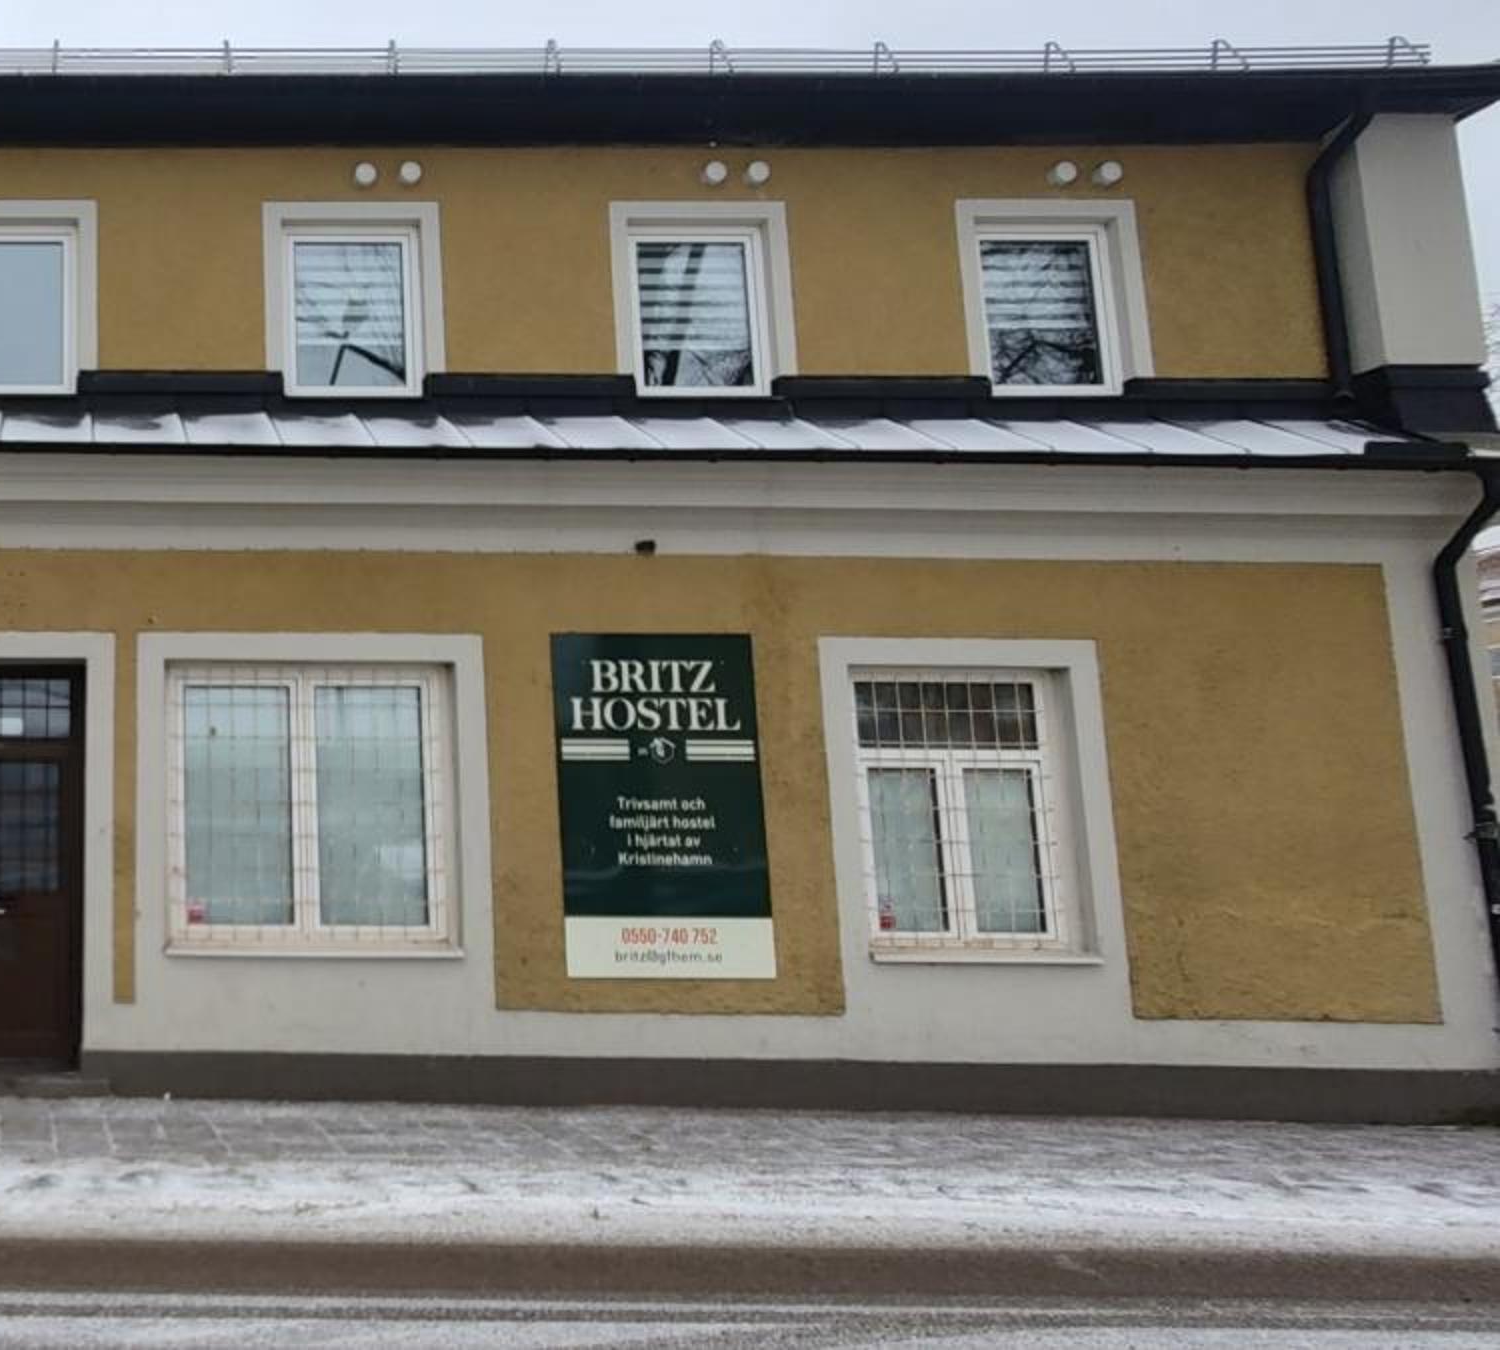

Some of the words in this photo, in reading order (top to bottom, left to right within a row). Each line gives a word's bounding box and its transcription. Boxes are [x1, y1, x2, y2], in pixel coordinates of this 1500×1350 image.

[590, 660, 716, 693] BRITZ
[570, 697, 741, 731] HOSTEL
[617, 796, 677, 811] Trivsamt
[681, 796, 706, 811] och
[609, 815, 669, 831] familjärt
[673, 815, 715, 829] hostel
[635, 833, 681, 850] hjärtat
[684, 836, 701, 848] av
[618, 852, 713, 866] Kristinehamn
[621, 927, 689, 945] 0550-740
[692, 927, 719, 945] 752
